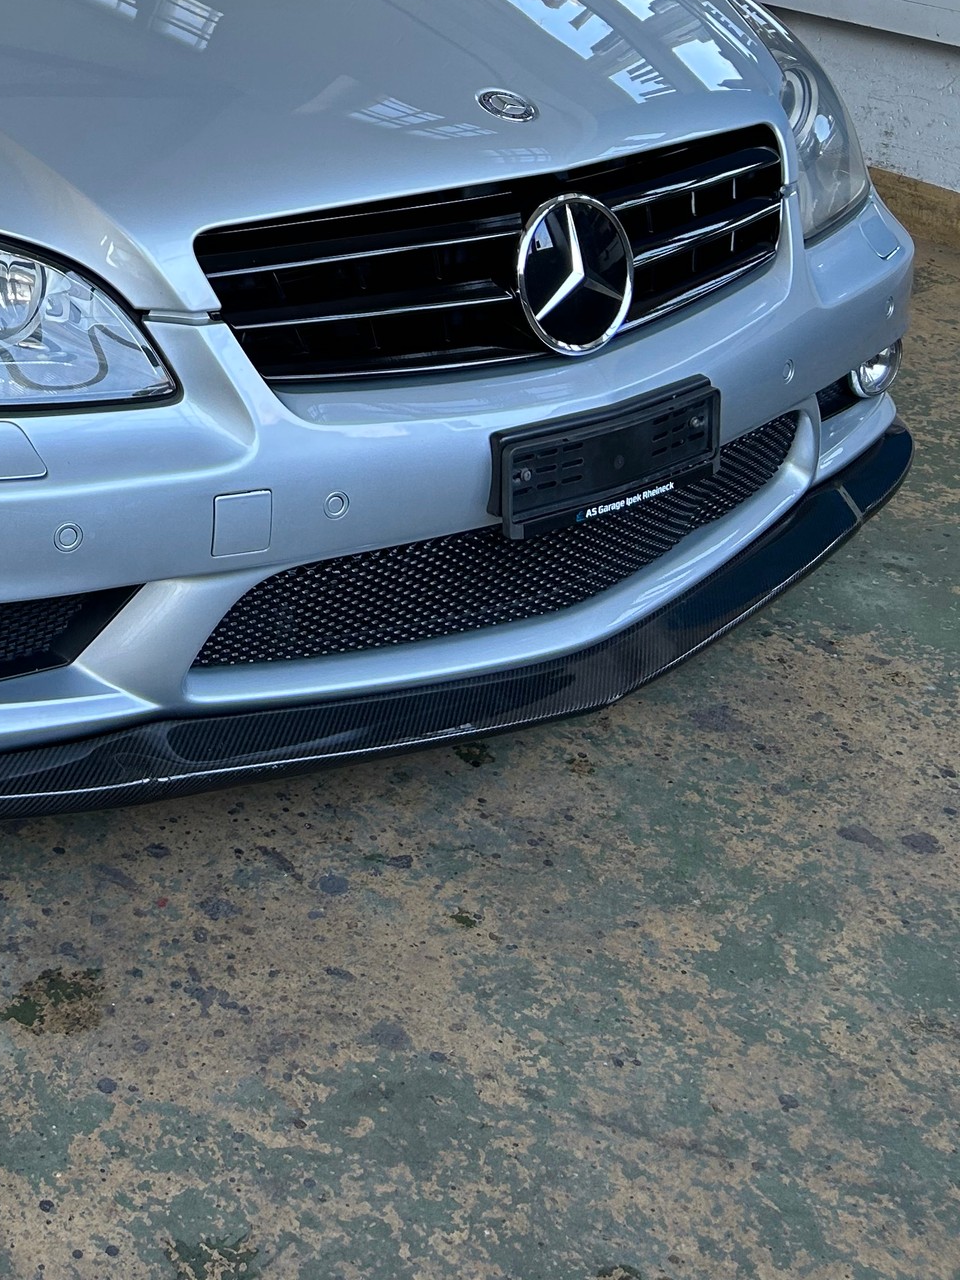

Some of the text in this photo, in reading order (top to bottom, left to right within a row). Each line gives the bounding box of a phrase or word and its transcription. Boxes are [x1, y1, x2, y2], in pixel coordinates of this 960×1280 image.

[585, 482, 674, 518] AS Garage Ipek Rheineck
